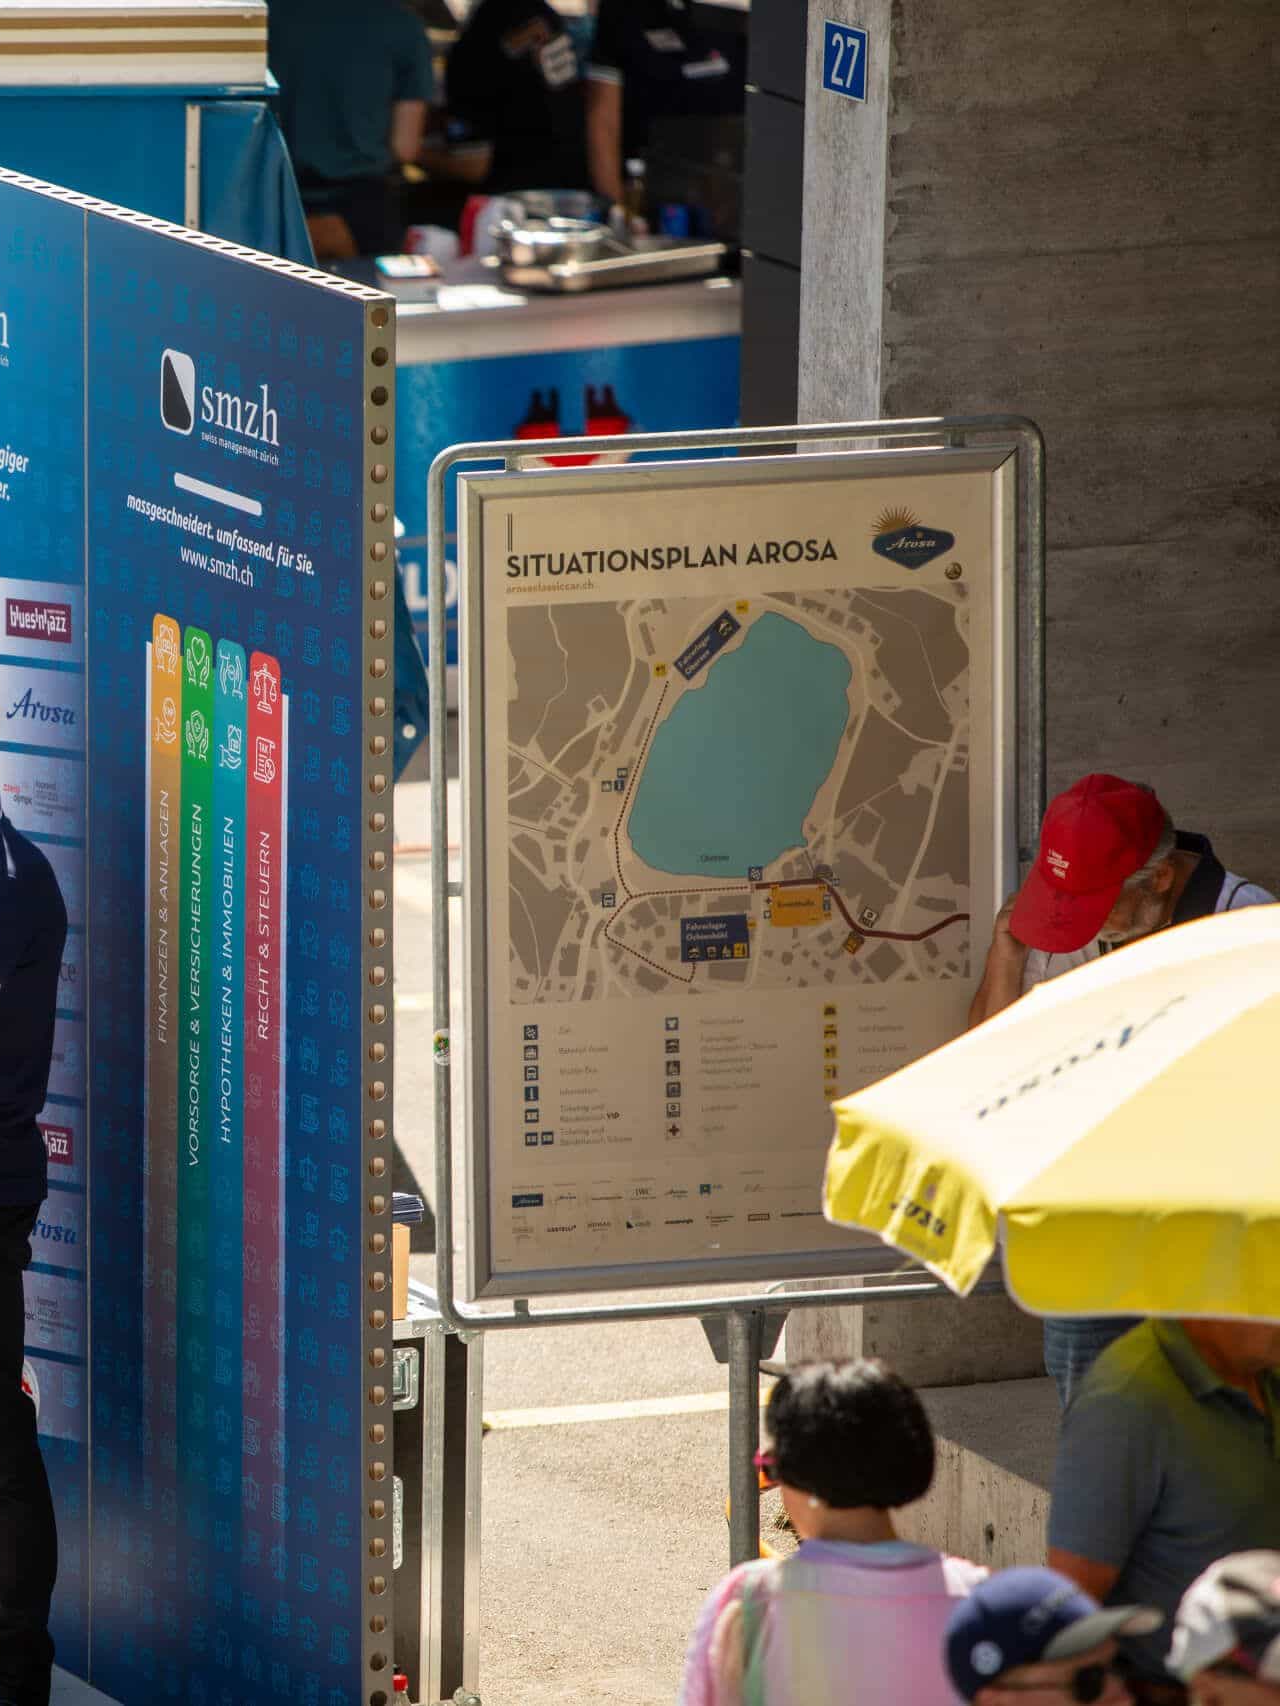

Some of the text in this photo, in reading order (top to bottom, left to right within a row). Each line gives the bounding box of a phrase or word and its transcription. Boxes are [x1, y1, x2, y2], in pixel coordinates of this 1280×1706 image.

[831, 32, 860, 88] 27
[201, 384, 280, 446] smzh
[201, 431, 280, 466] swiss management zürich
[127, 493, 315, 576] massgeschneidert. umfassend. für Sie.
[506, 538, 839, 578] SITUATIONSPLAN AROSA
[885, 536, 937, 551] Arosa
[180, 545, 254, 588] www.smzh.ch
[6, 687, 77, 726] Arosa
[157, 790, 170, 1044] FINANZEN & ANLAGEN
[257, 831, 270, 1040] RECHT & STEUERN
[188, 803, 202, 1167] VORSORGE & VERSICHERUNGEN
[219, 816, 234, 1144] HYPOTHEKEN & IMMOBILIEN
[32, 1219, 77, 1245] rosa
